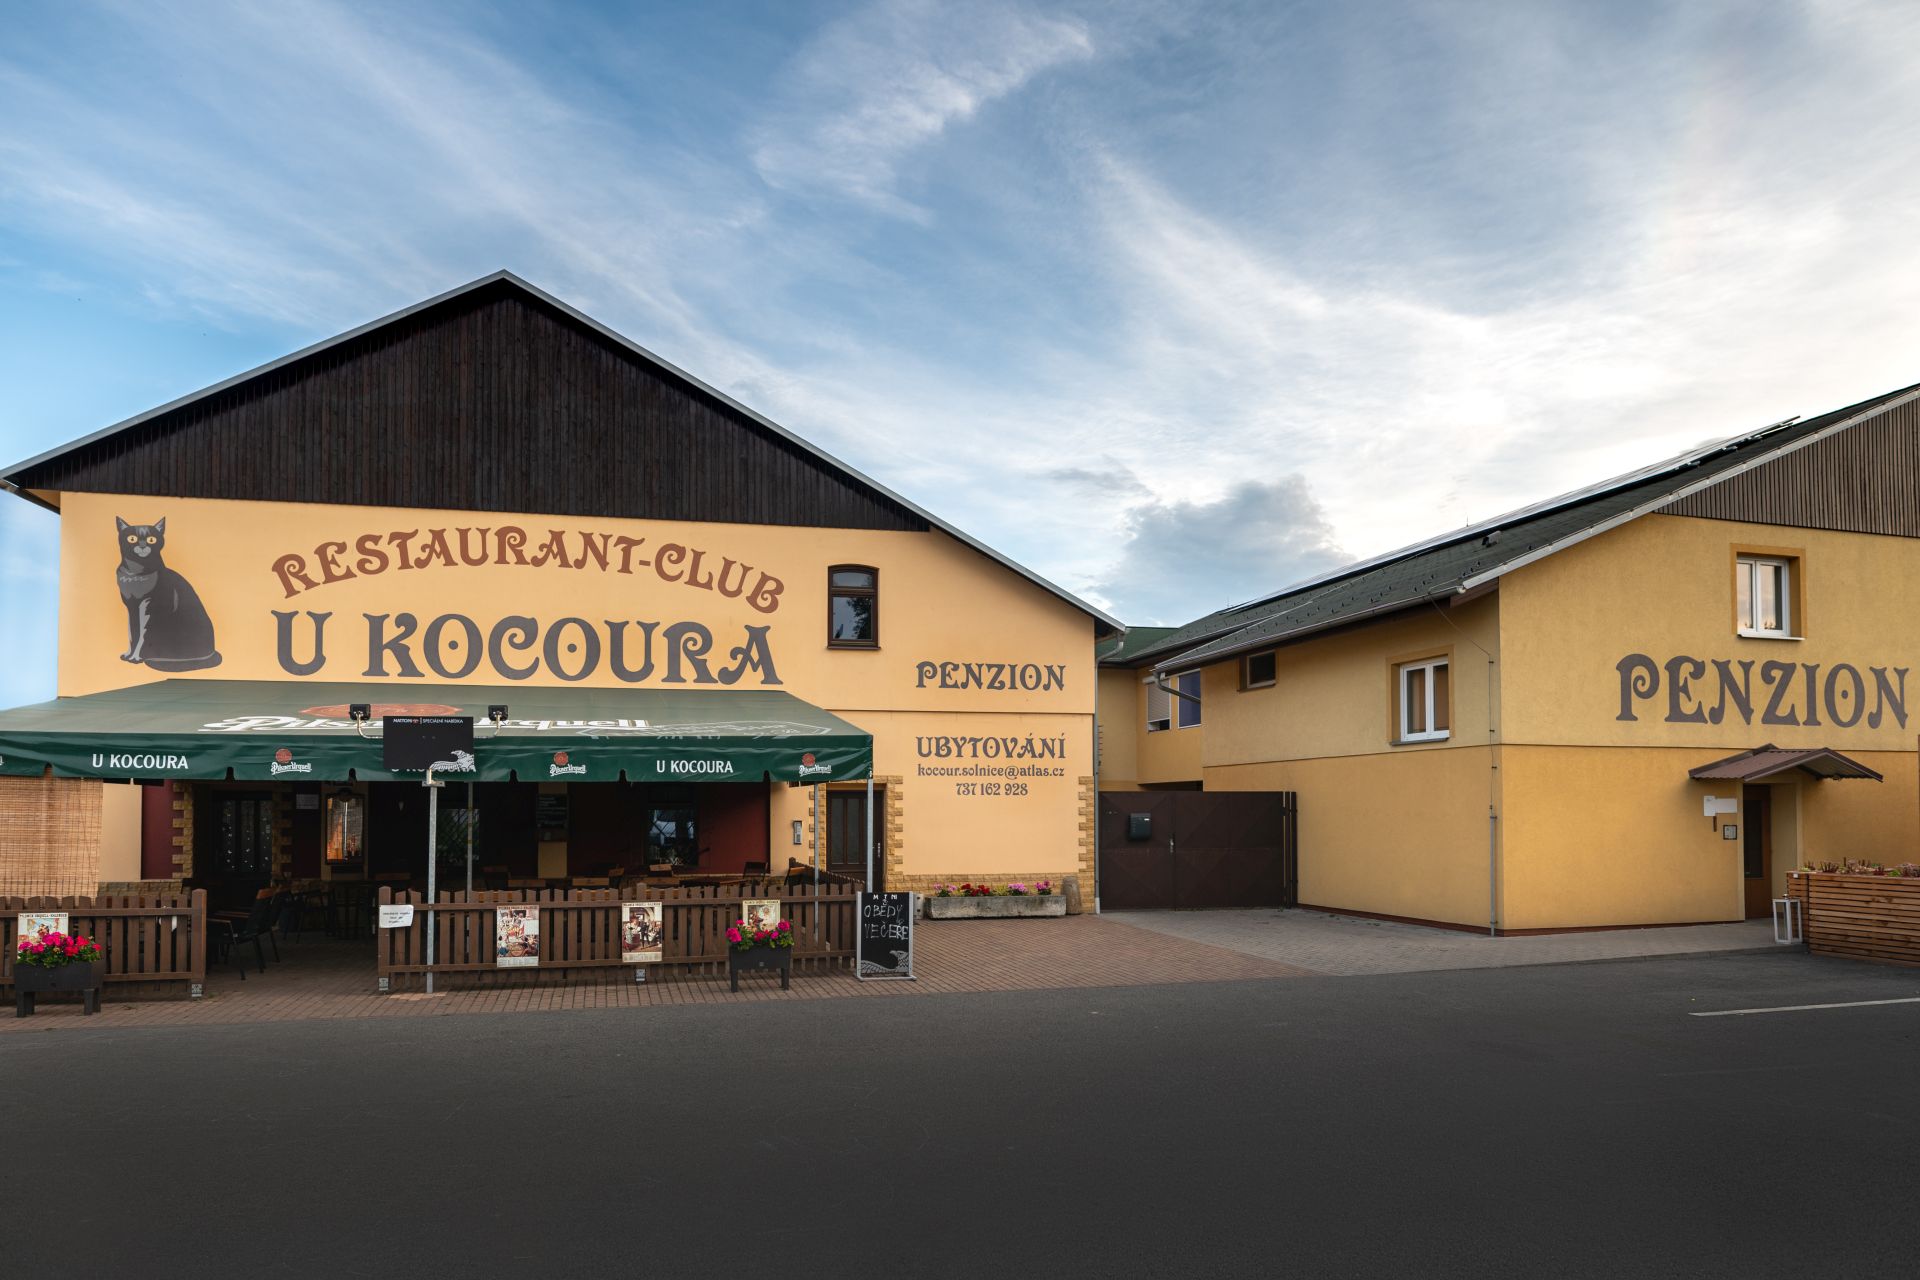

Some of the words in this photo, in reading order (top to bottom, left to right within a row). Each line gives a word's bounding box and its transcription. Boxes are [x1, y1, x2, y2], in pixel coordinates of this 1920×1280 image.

[271, 525, 785, 614] RESTAURANT-CLUB
[271, 609, 333, 676] U
[361, 612, 783, 685] KOCOURA
[916, 661, 1066, 691] PENZION
[1615, 653, 1910, 729] PENZION
[916, 733, 1066, 759] UBYTOVÁNÍ
[92, 753, 103, 768] U
[109, 754, 189, 769] KOCOURA
[656, 760, 666, 773] U
[670, 760, 734, 773] KOCOURA
[917, 764, 1065, 780] kocour.solnice@atlas.cz
[956, 783, 977, 796] 737
[980, 783, 1001, 796] 162
[1004, 783, 1028, 796] 928
